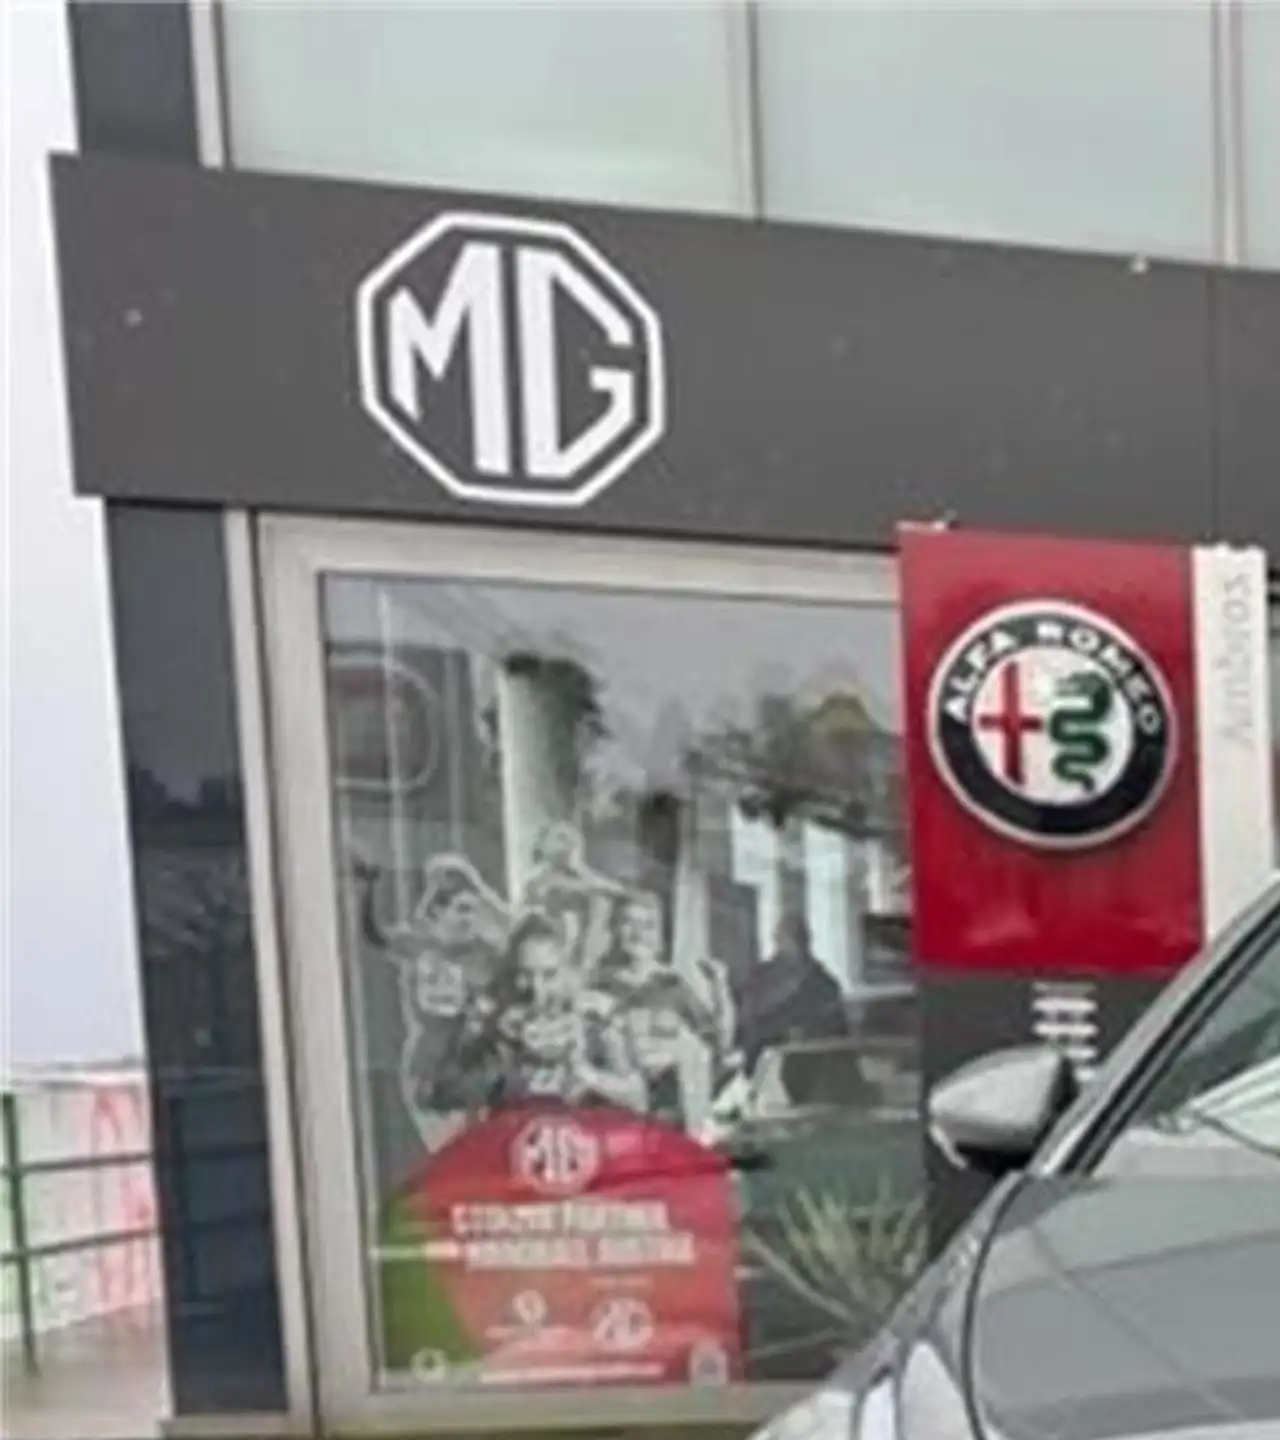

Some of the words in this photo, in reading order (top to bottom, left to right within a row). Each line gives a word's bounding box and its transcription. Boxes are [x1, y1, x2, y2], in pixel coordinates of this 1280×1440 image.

[385, 240, 636, 480] MG
[945, 628, 1017, 723] ALFA
[1035, 619, 1162, 735] ROMEO
